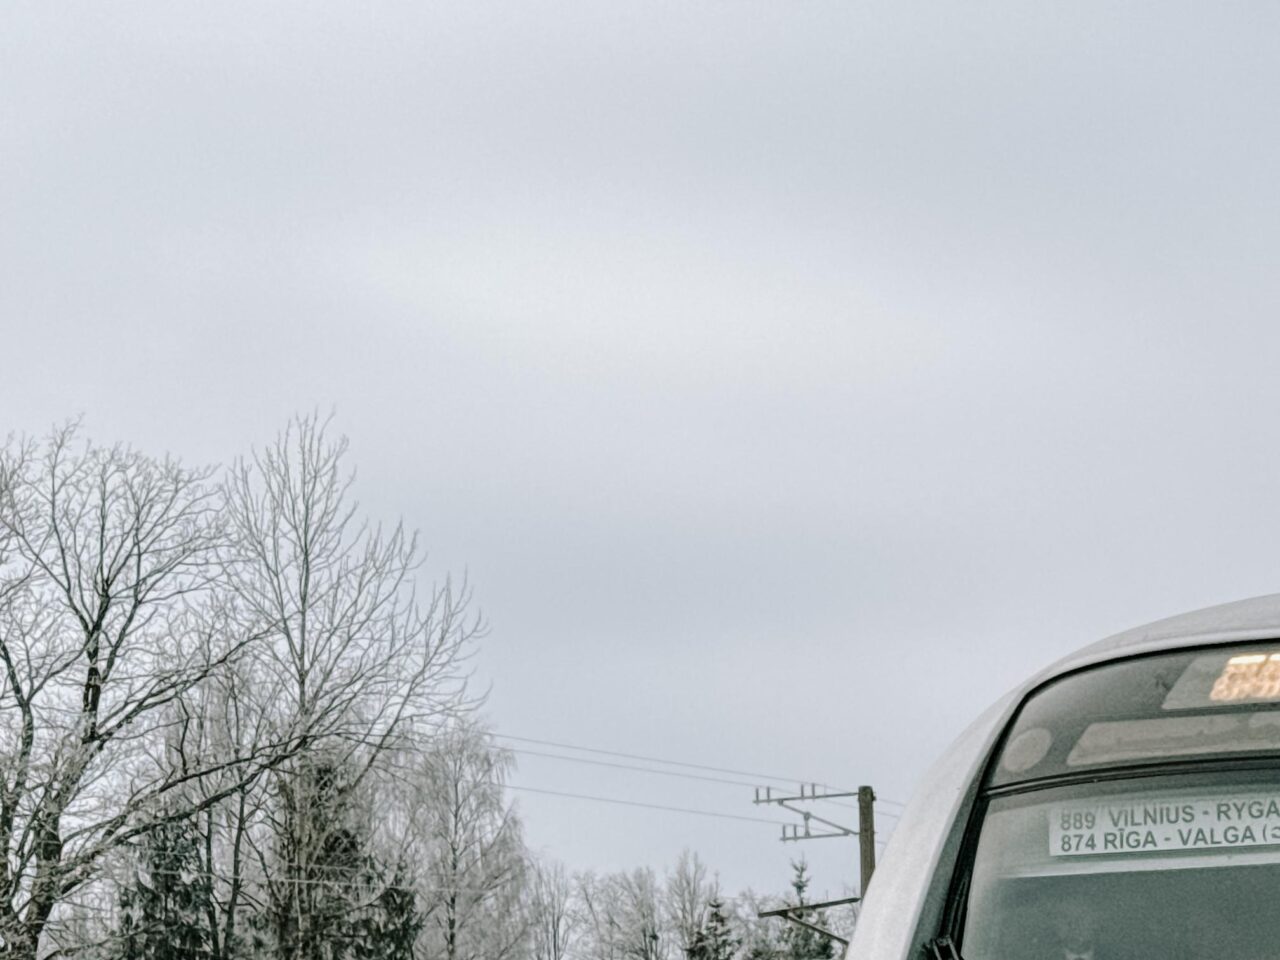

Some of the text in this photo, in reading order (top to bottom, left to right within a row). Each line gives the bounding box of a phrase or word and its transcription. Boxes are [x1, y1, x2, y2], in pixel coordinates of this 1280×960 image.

[1109, 804, 1195, 828] VILNIUS
[1061, 832, 1097, 852] 874
[1104, 828, 1157, 850] RĪGA
[1177, 825, 1256, 846] VALGA
